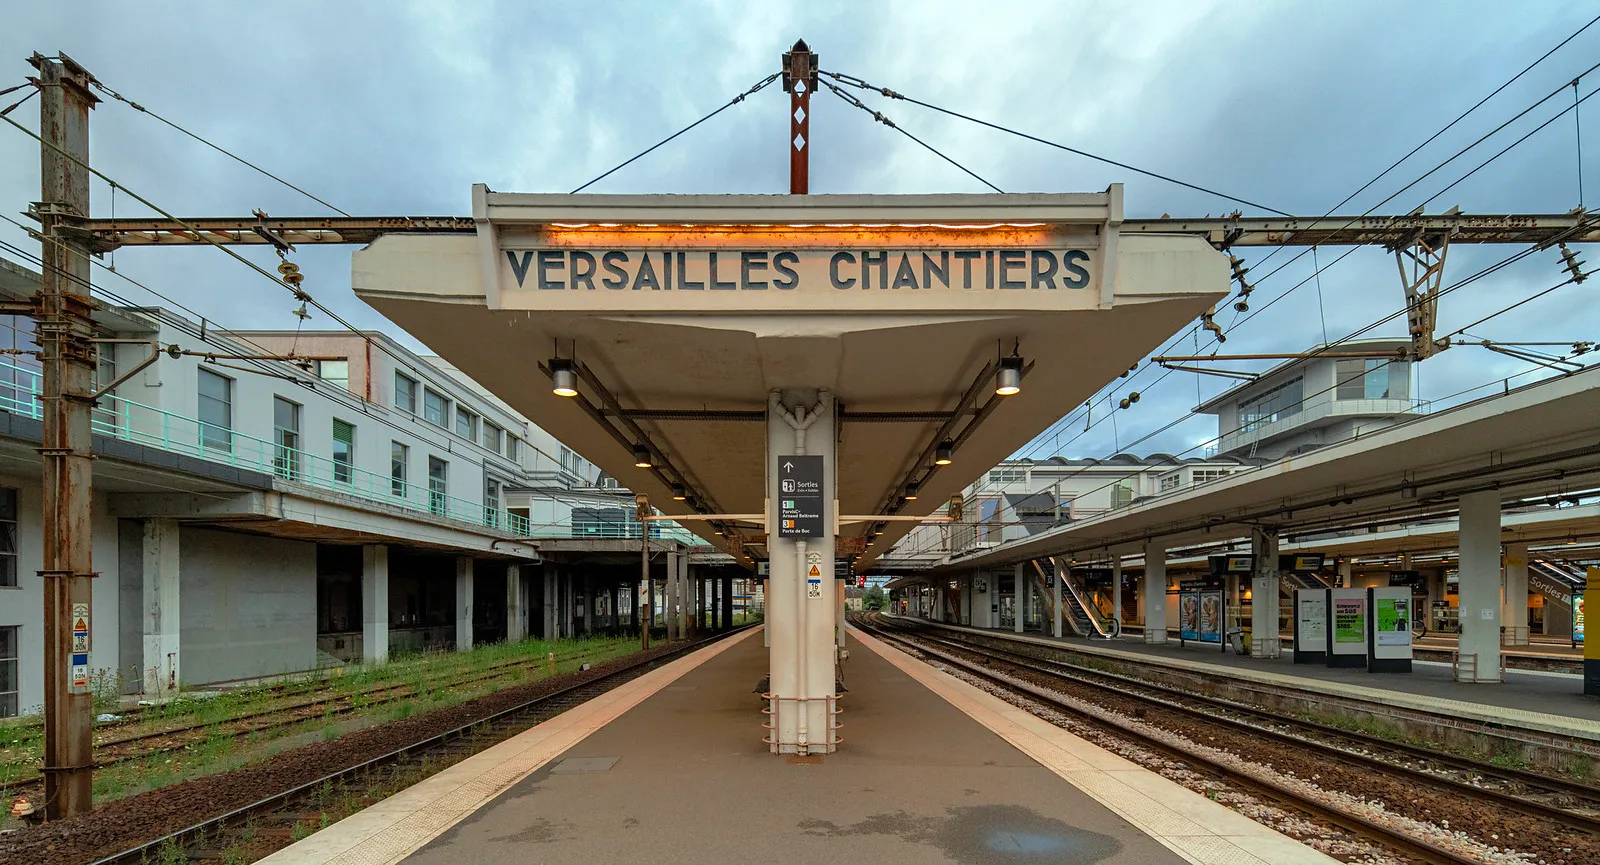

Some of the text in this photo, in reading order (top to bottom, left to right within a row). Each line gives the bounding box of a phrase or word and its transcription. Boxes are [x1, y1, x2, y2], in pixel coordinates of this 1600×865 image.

[506, 250, 1091, 290] VERSAILLES CHANTIERS
[1530, 576, 1562, 599] Sorties
[77, 636, 84, 644] 16
